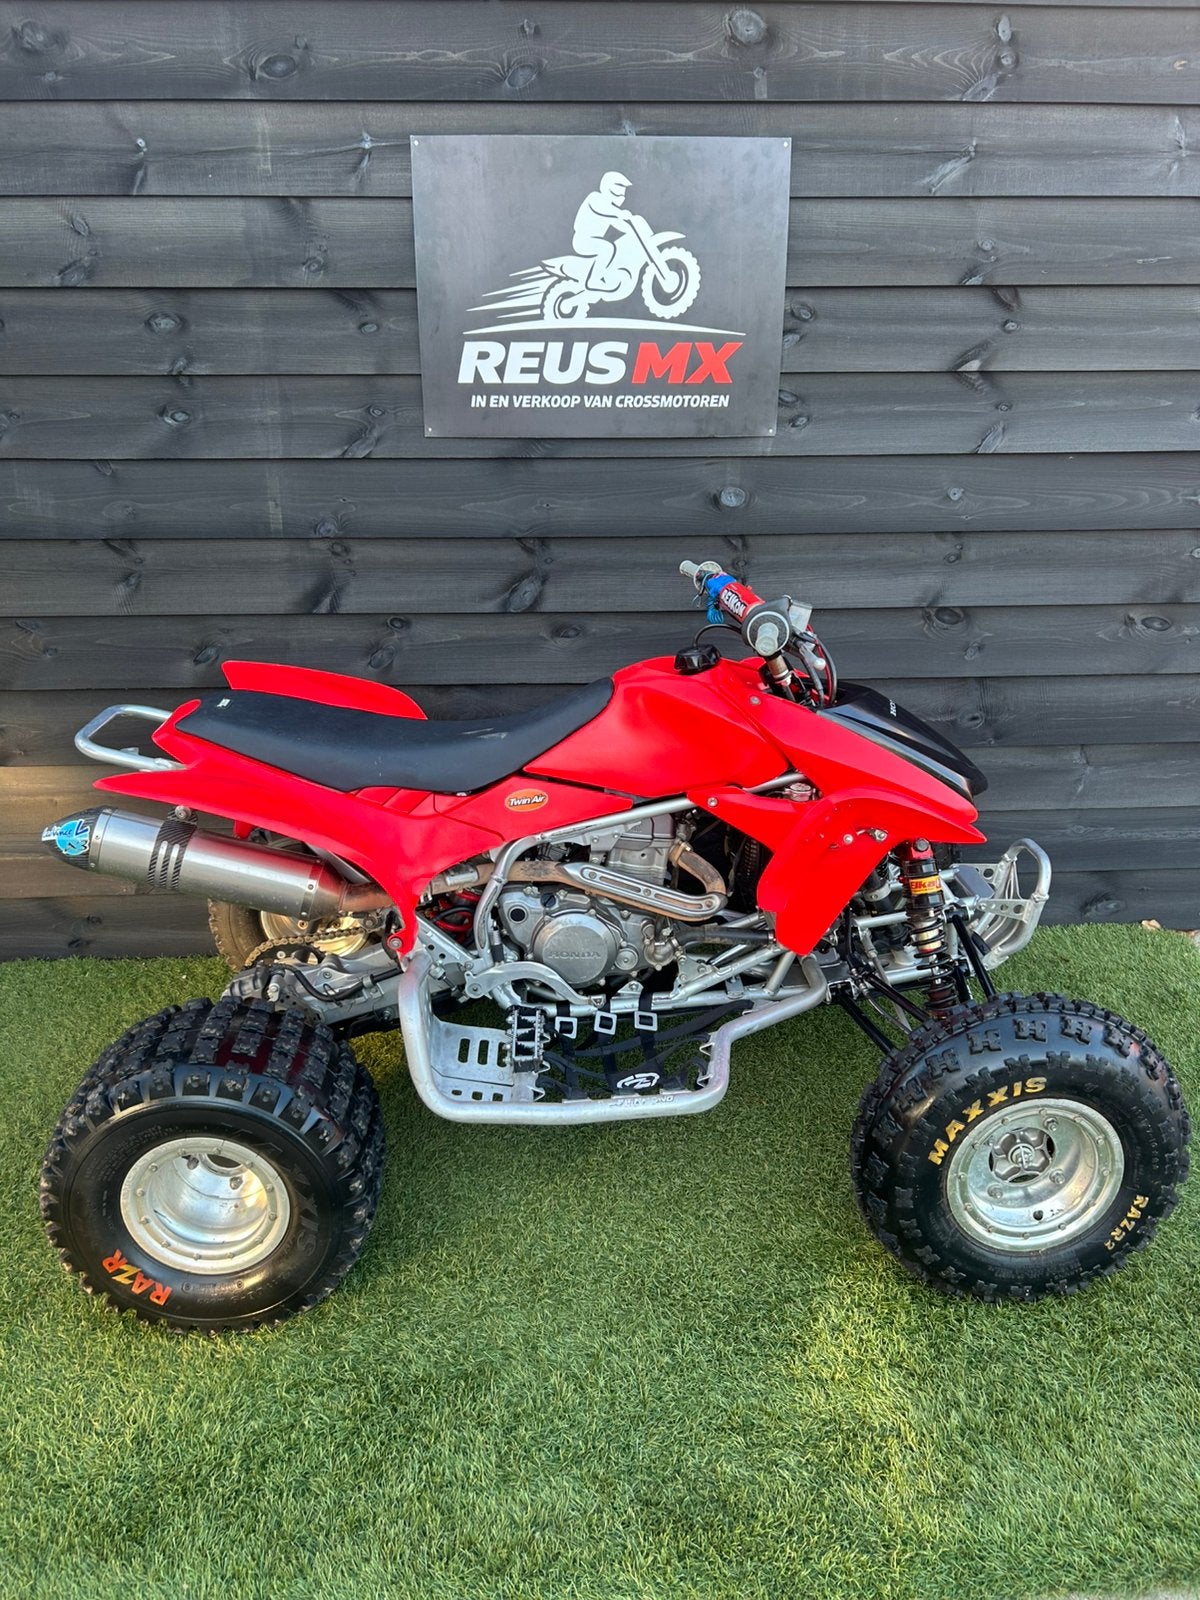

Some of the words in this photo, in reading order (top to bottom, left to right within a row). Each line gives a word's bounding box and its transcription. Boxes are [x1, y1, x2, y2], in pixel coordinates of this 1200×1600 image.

[457, 340, 629, 385] REUS
[631, 342, 743, 384] MX
[470, 395, 487, 408] IN
[489, 395, 509, 408] EN
[512, 395, 581, 408] VERKOOP
[583, 395, 613, 408] VAN
[615, 395, 730, 408] CROSSMOTOREN
[509, 797, 531, 807] Twin
[531, 794, 546, 804] Air
[548, 950, 602, 960] HONDA
[928, 1077, 1047, 1166] MAXXIS
[1110, 1194, 1150, 1242] RAZR
[101, 1248, 173, 1306] RAZR
